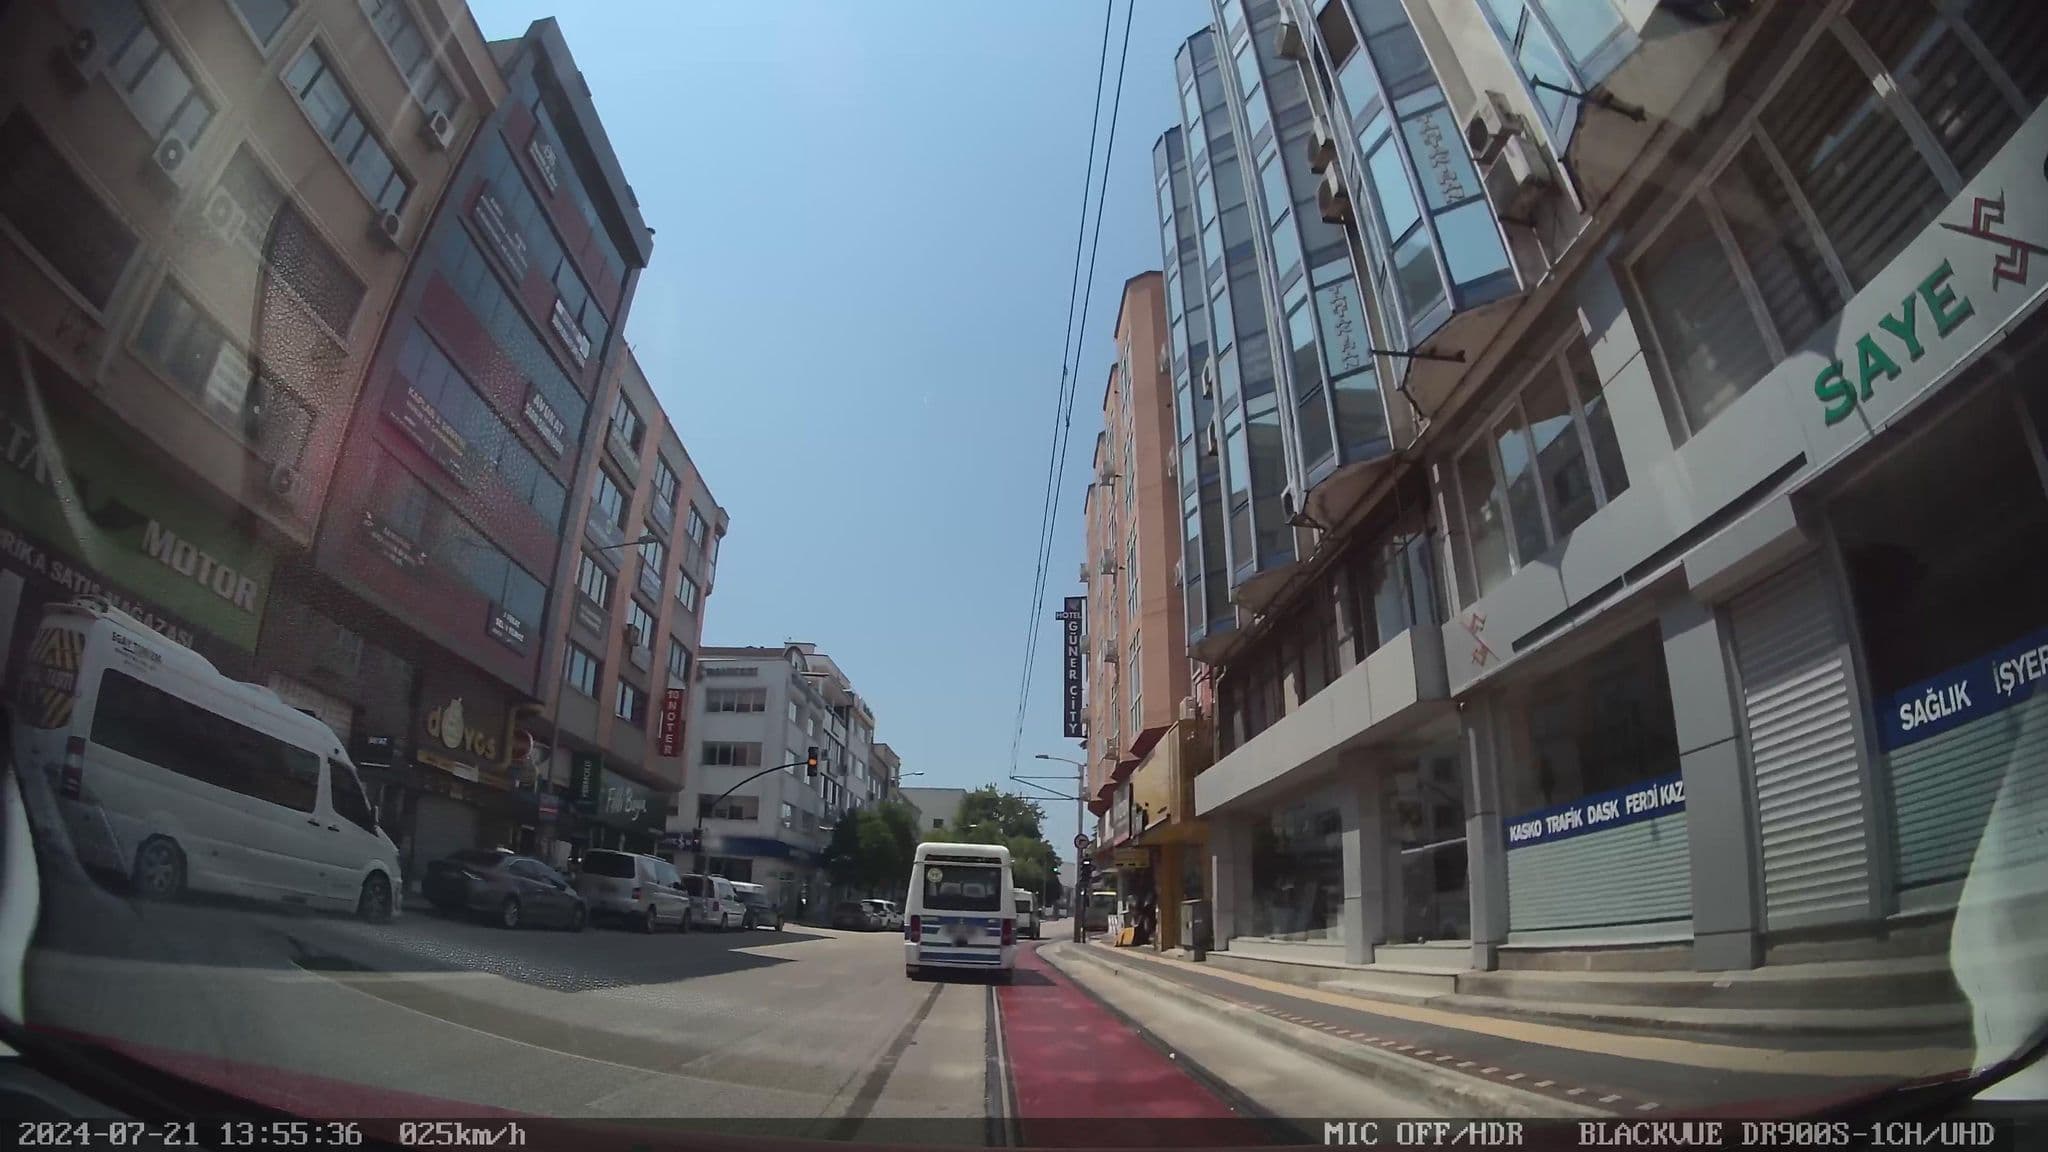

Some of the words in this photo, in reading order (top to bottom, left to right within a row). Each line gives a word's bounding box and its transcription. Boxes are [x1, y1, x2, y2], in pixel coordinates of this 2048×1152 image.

[1814, 257, 1976, 427] SAYE
[142, 518, 258, 616] MOTOR
[1056, 611, 1082, 619] HOTEL
[1068, 621, 1079, 680] GÜNER
[663, 701, 678, 755] NOTER
[1900, 680, 1972, 731] SAĞLIK
[1509, 819, 1542, 842] KASKO
[1546, 806, 1583, 834] TRAFİK
[1587, 799, 1620, 825] DASK
[1625, 784, 1660, 815] FERDİ
